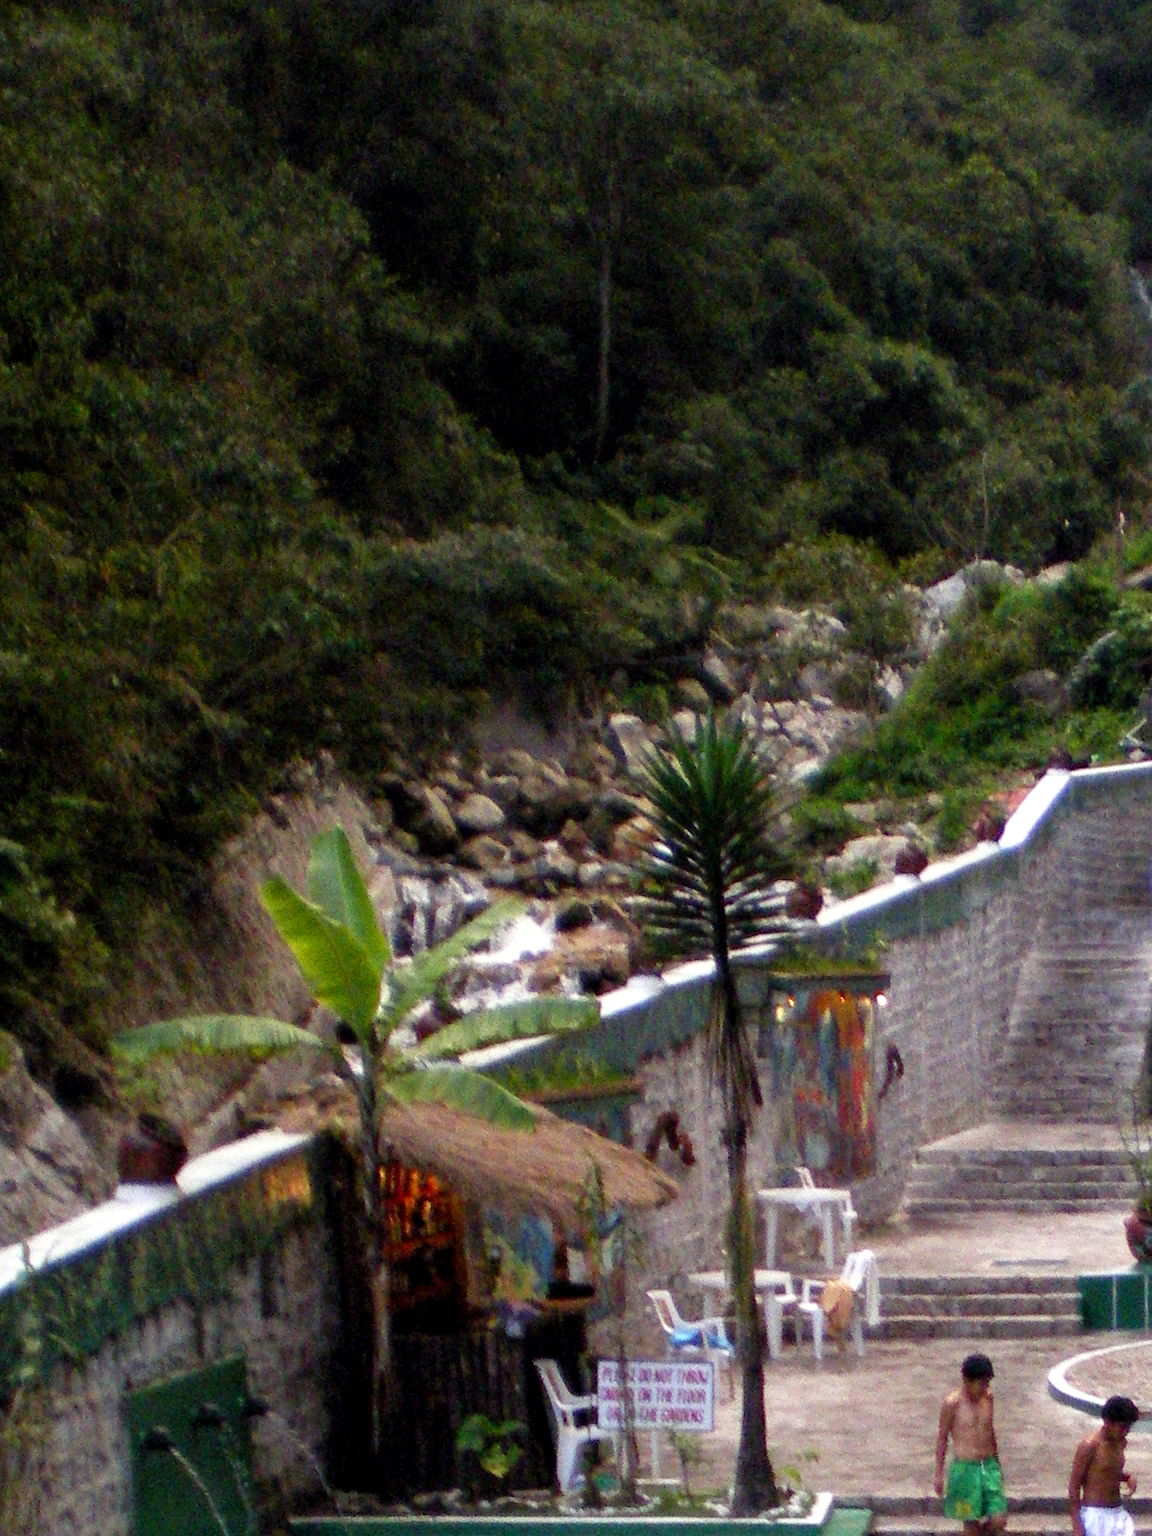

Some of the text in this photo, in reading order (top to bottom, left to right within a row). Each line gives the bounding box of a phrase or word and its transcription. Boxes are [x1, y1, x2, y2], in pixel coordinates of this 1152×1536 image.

[655, 1368, 673, 1383] NOT
[656, 1387, 673, 1402] THE
[677, 1388, 707, 1404] FLOOR
[640, 1407, 657, 1421] THE
[661, 1407, 704, 1423] GARDENS
